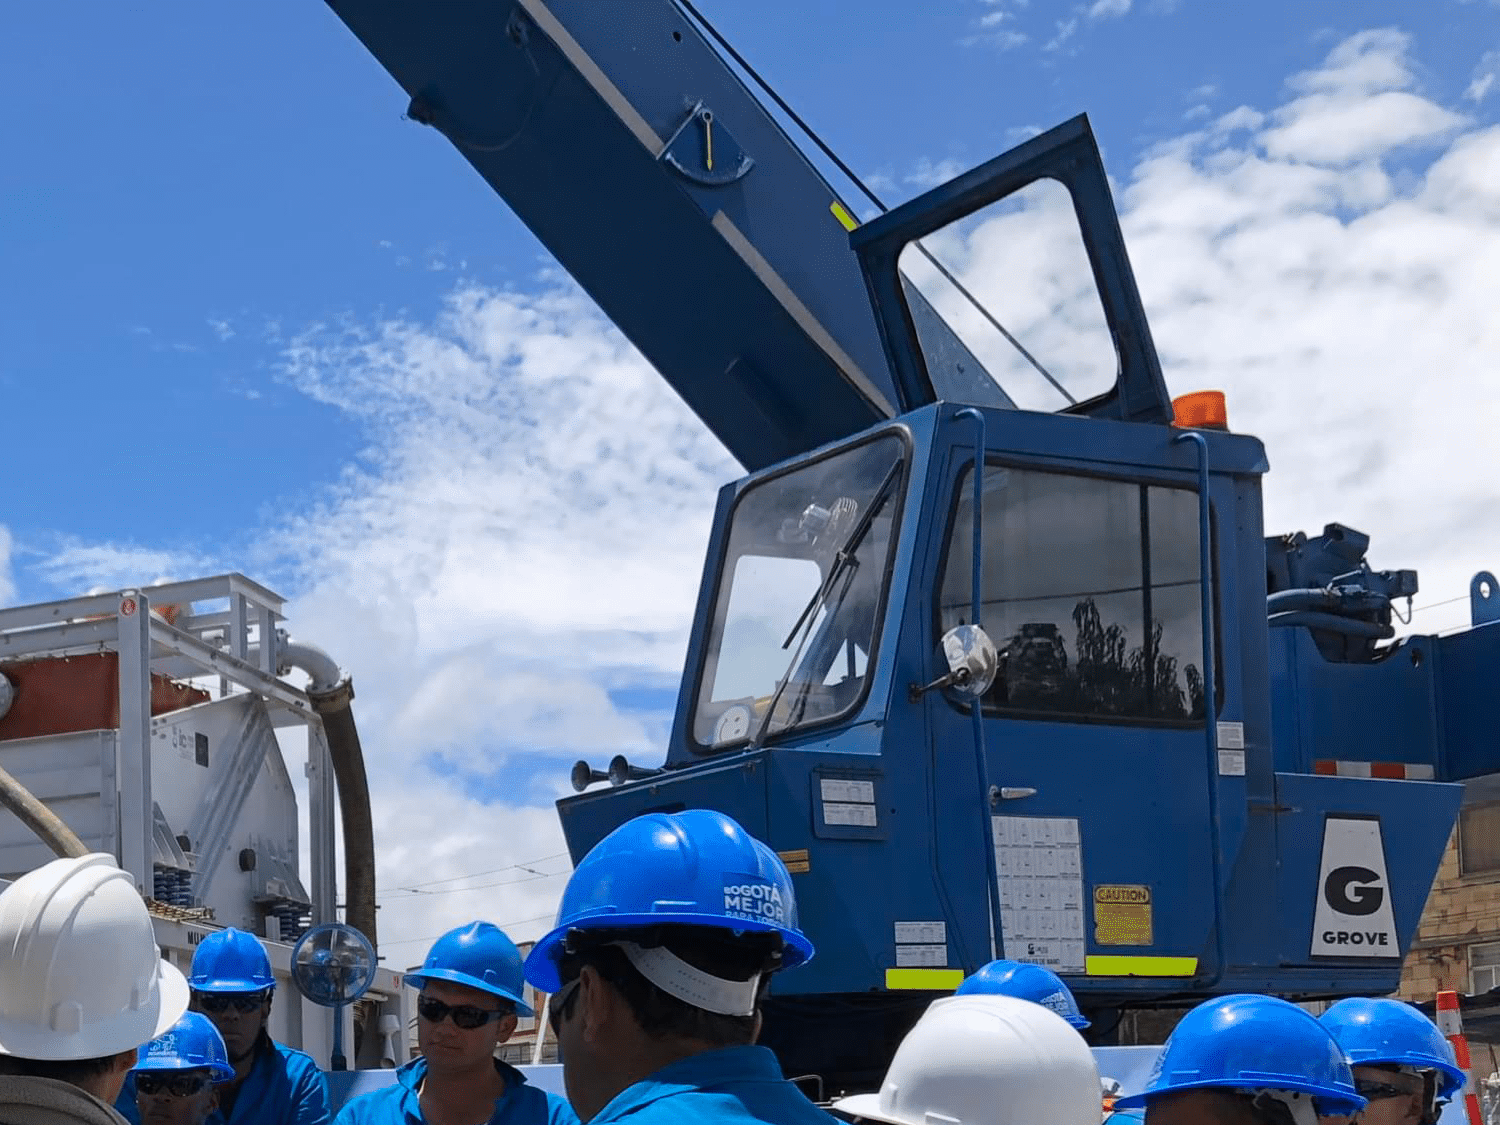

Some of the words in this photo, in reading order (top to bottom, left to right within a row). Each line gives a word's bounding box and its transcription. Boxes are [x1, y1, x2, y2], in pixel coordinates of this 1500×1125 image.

[723, 883, 783, 907] BOGOTÁ
[1097, 889, 1147, 900] CAUTION
[1325, 865, 1384, 916] G
[724, 895, 785, 922] MEJOR
[1322, 931, 1388, 946] GROVE
